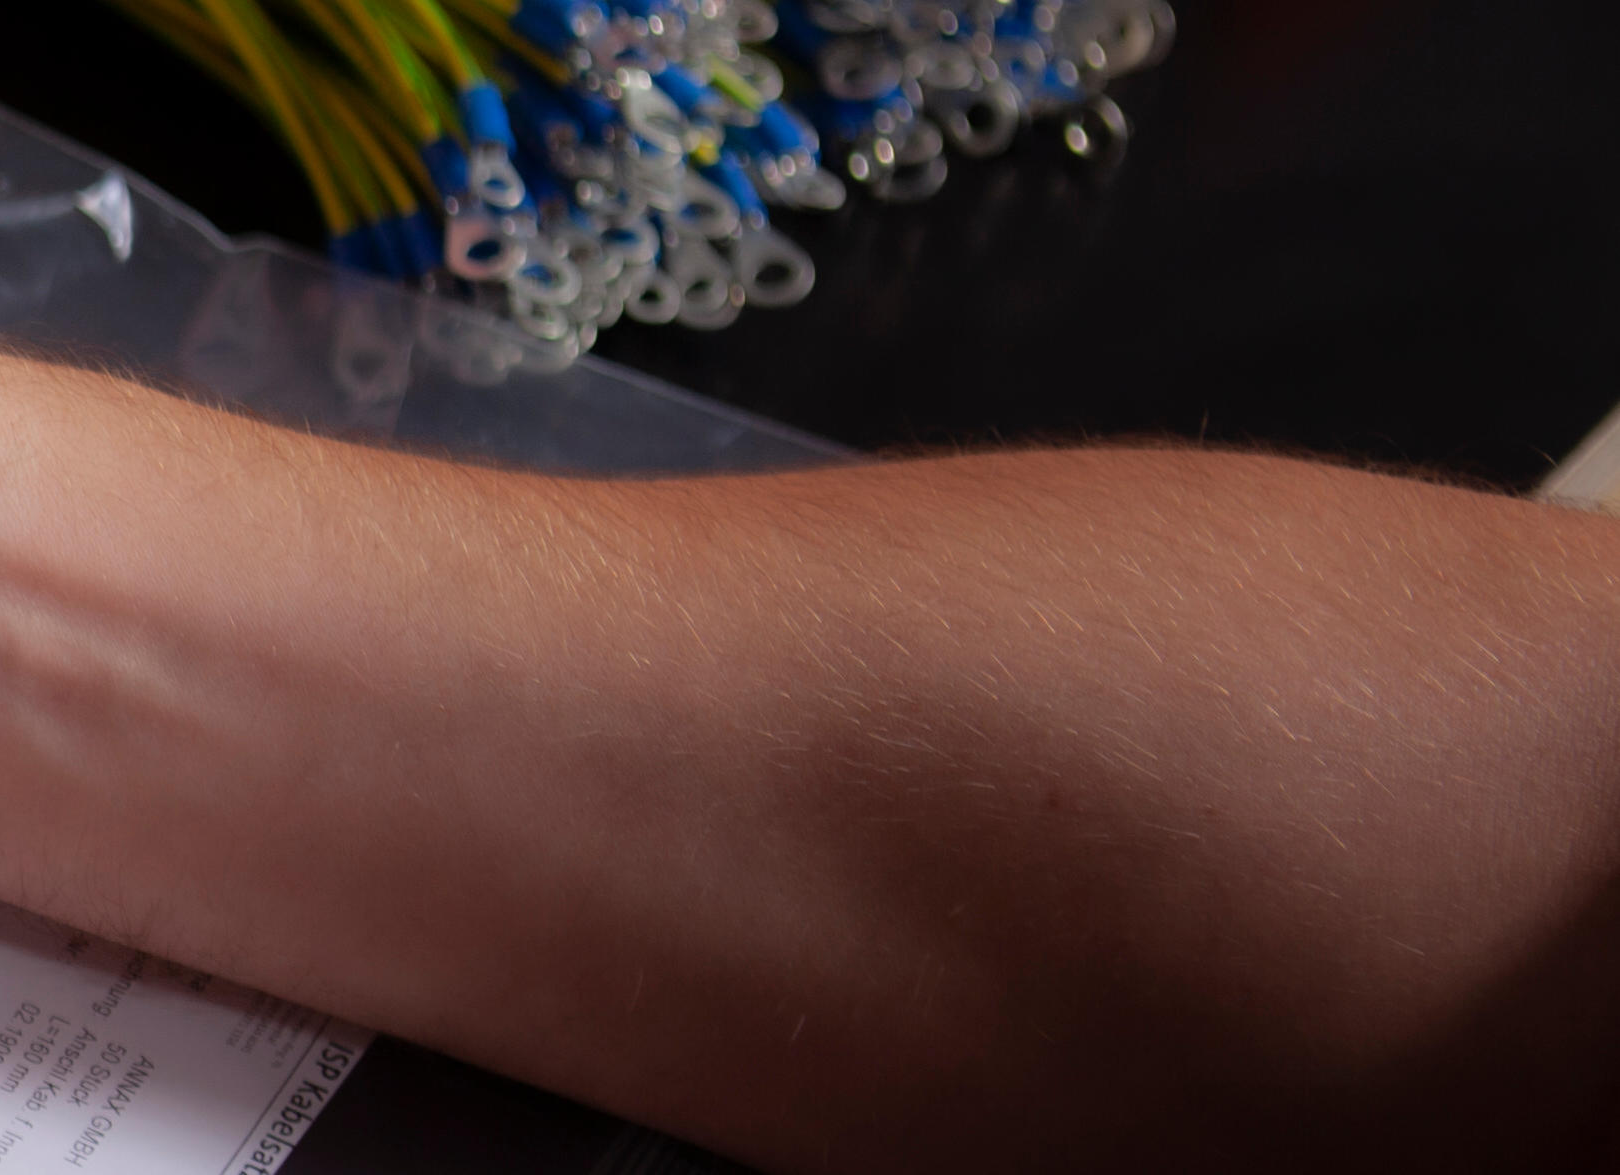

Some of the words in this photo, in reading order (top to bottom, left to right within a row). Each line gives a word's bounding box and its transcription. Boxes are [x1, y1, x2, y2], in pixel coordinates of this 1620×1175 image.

[23, 1014, 71, 1065] L=160
[101, 1042, 128, 1066] 50
[316, 1041, 354, 1081] ISP
[0, 1062, 30, 1094] mm
[102, 1054, 156, 1117] ANNAX
[64, 1114, 114, 1168] GMBH
